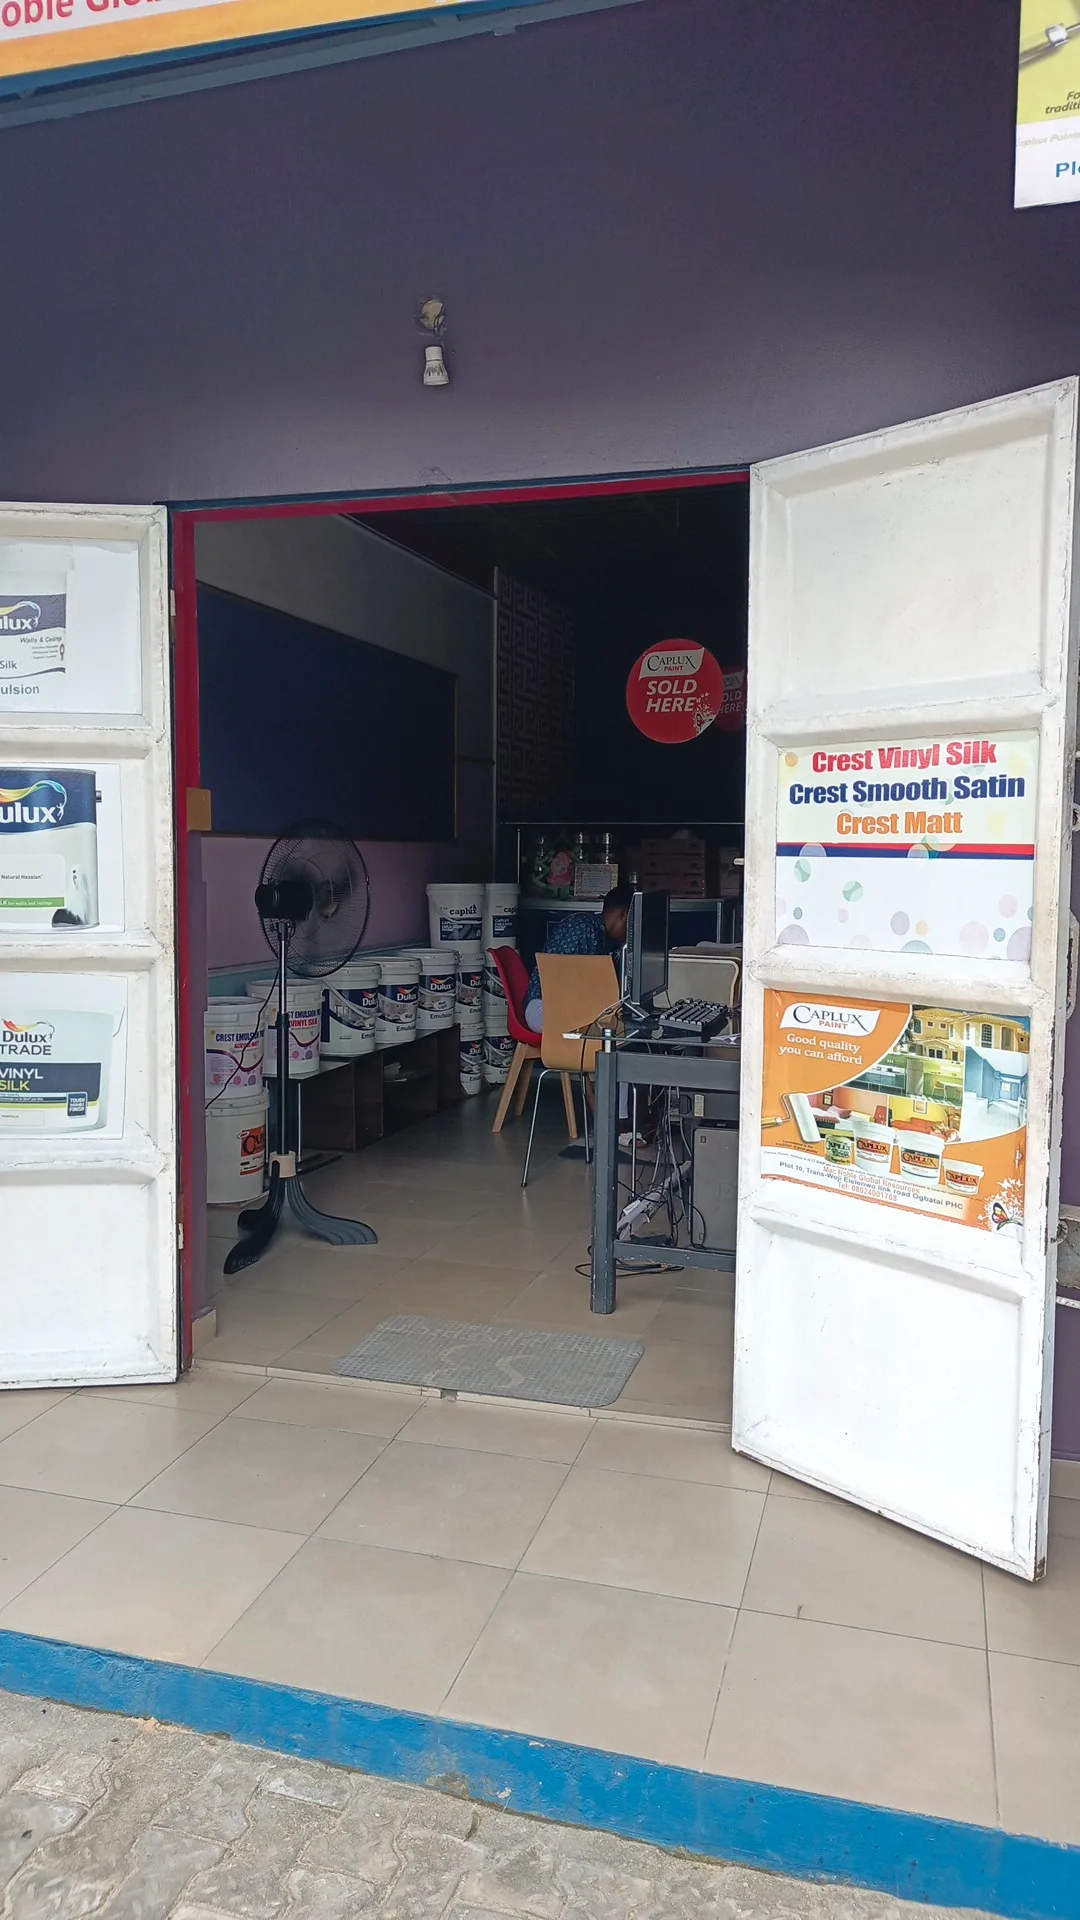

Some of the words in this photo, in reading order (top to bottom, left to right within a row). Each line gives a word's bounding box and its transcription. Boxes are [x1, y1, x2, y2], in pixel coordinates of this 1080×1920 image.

[1056, 161, 1080, 178] Pl
[0, 615, 33, 630] lux
[0, 660, 18, 669] Silk
[647, 655, 697, 672] CAPLUX
[1, 684, 40, 695] ulsion
[646, 679, 698, 695] SOLD
[646, 697, 697, 713] HERE
[812, 750, 873, 773] Crest
[878, 743, 940, 769] Vinyl
[946, 740, 997, 765] Silk
[789, 782, 848, 805] Crest
[852, 777, 947, 803] Smooth
[953, 774, 1025, 799] Satin
[836, 812, 899, 835] Crest
[904, 811, 963, 835] Matt
[449, 907, 477, 916] caplux
[793, 1005, 870, 1032] CAPLUX
[818, 1020, 848, 1029] PAINT
[2, 1031, 48, 1043] Dulux
[215, 1033, 235, 1042] CREST
[786, 1033, 816, 1046] Good
[819, 1040, 861, 1054] quality
[0, 1044, 52, 1056] TRADE
[778, 1046, 801, 1055] you
[804, 1049, 824, 1059] can
[827, 1052, 863, 1065] afford
[0, 1068, 43, 1079] VINYL
[0, 1080, 30, 1091] SILK
[902, 1152, 937, 1168] CAPLUX
[779, 1161, 793, 1169] Plot
[893, 1189, 911, 1198] road
[945, 1201, 963, 1210] PHC
[823, 1165, 836, 1174] Mac
[837, 1168, 857, 1179] Noble
[857, 1173, 880, 1185] Global
[882, 1180, 920, 1194] Resources
[838, 1182, 850, 1190] Tel:
[946, 1170, 978, 1186] CAPLUX
